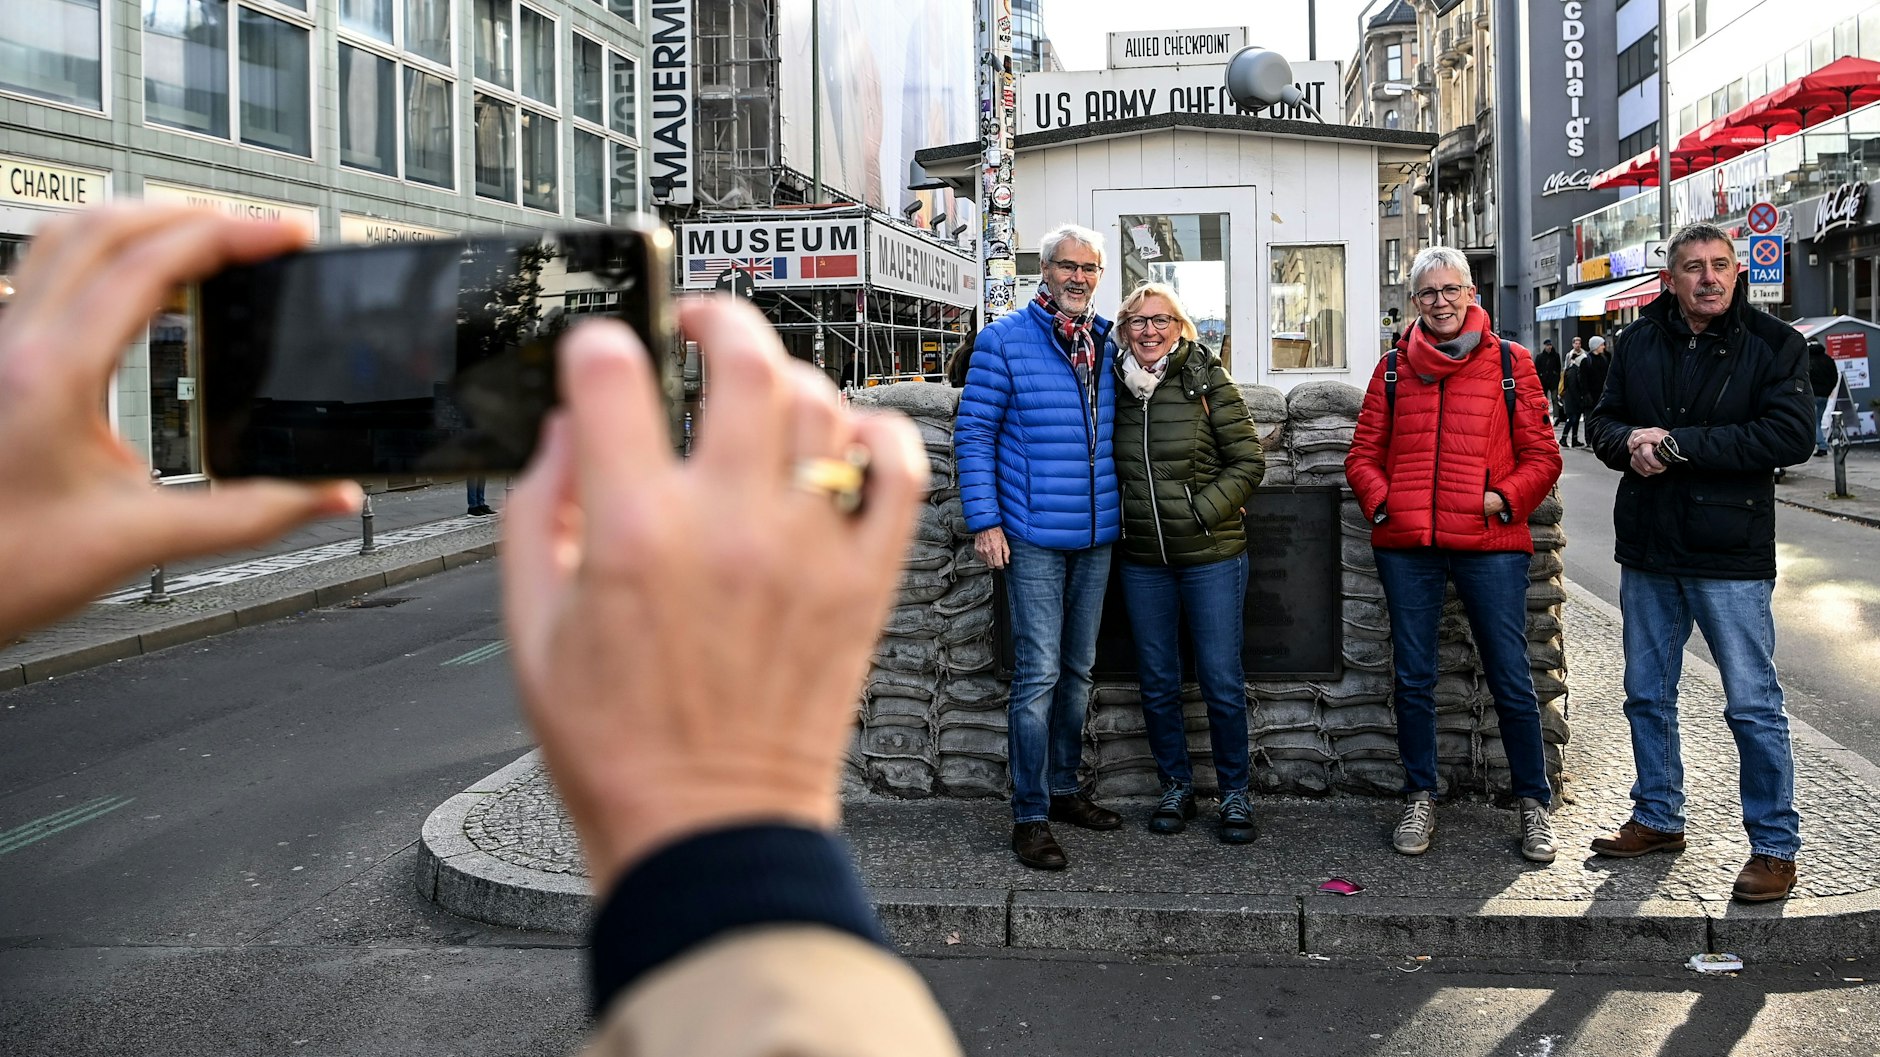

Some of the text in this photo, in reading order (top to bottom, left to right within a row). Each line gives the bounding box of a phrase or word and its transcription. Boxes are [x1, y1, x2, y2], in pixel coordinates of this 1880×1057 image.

[1125, 33, 1230, 58] ALLIED CHECKPOINT
[652, 0, 687, 188] MAUERM
[1561, 0, 1591, 157] cDonald's
[1036, 92, 1071, 129] US
[1085, 88, 1157, 123] ARMY
[1169, 81, 1325, 119] CHECNT
[10, 167, 87, 204] CHARLIE
[1543, 168, 1604, 194] McCaf
[1676, 172, 1715, 227] SNACKS
[1728, 150, 1772, 213] COFFEE
[1814, 181, 1860, 237] McCafé
[689, 225, 858, 255] MUSEUM
[878, 234, 959, 295] MAUERMUSEUM
[1752, 269, 1780, 280] TAXI
[1752, 290, 1758, 298] 5
